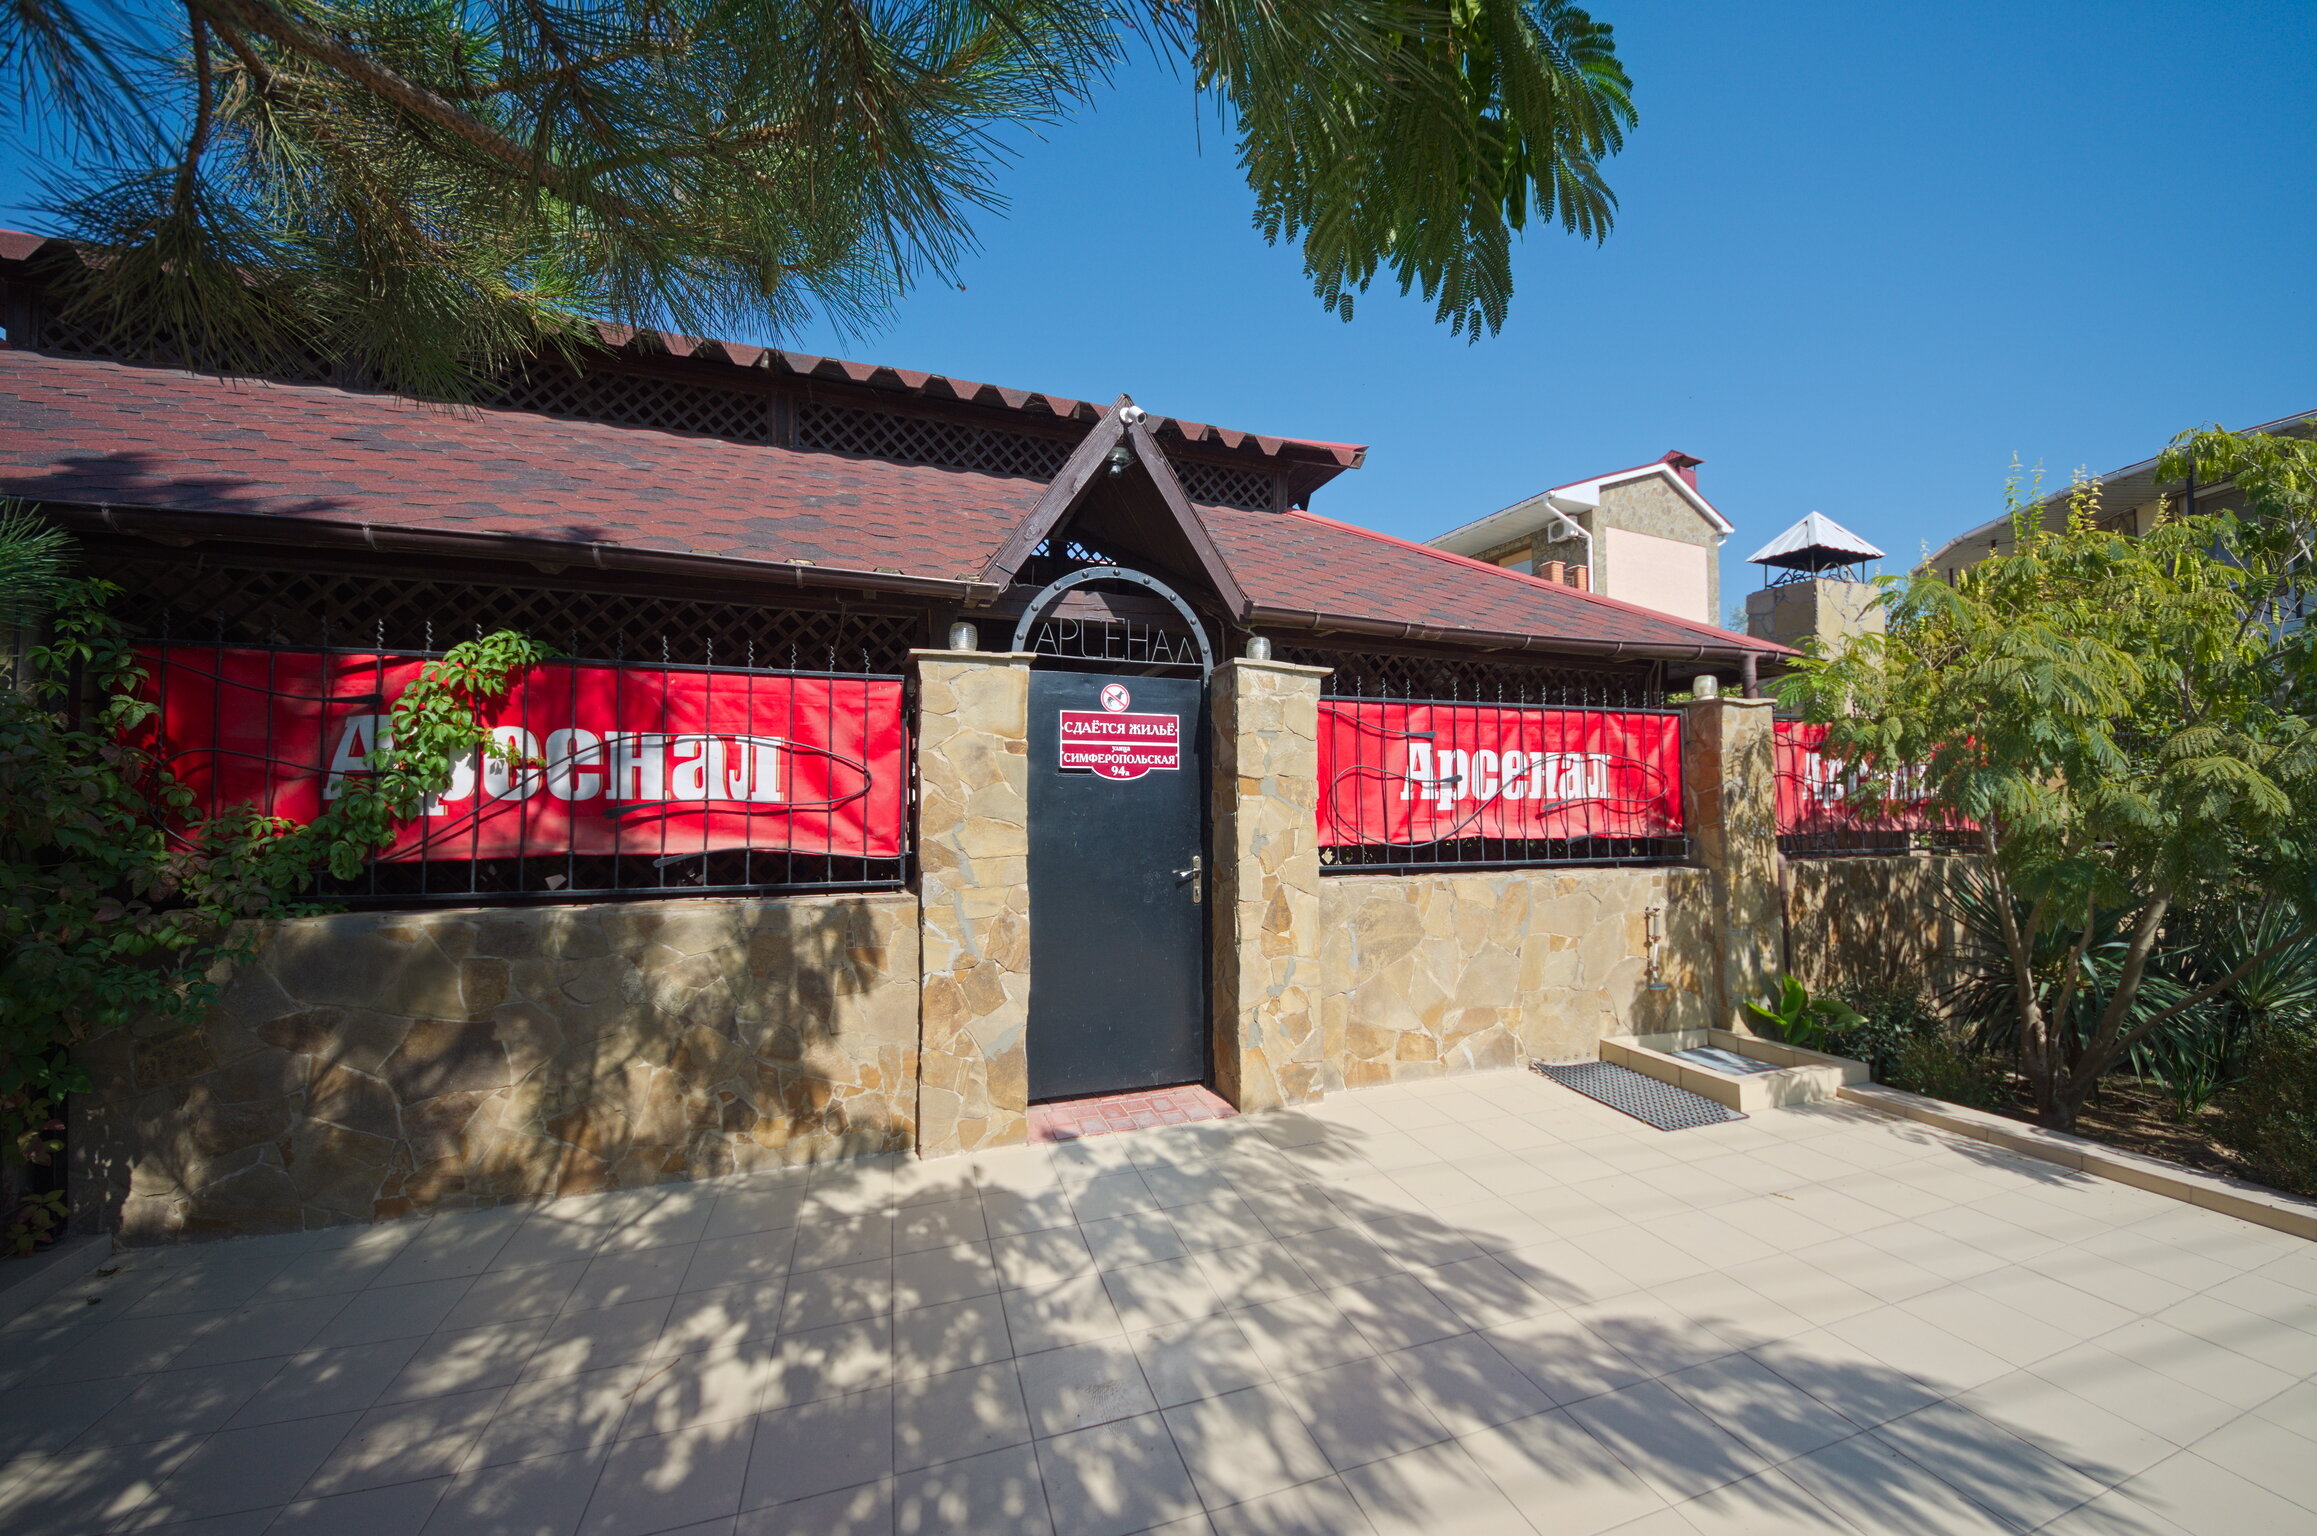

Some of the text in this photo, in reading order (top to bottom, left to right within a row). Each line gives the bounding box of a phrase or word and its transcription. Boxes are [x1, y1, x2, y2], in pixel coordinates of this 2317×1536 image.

[1033, 616, 1196, 664] АРСЕНАЛ
[1064, 720, 1176, 736] СДАЁТСЯ ЖИЛЬЁ
[1063, 752, 1176, 765] СИМФЕРОПОЛЬСКАЯ
[1111, 765, 1130, 776] 94а
[1399, 742, 1612, 811] Арсенал
